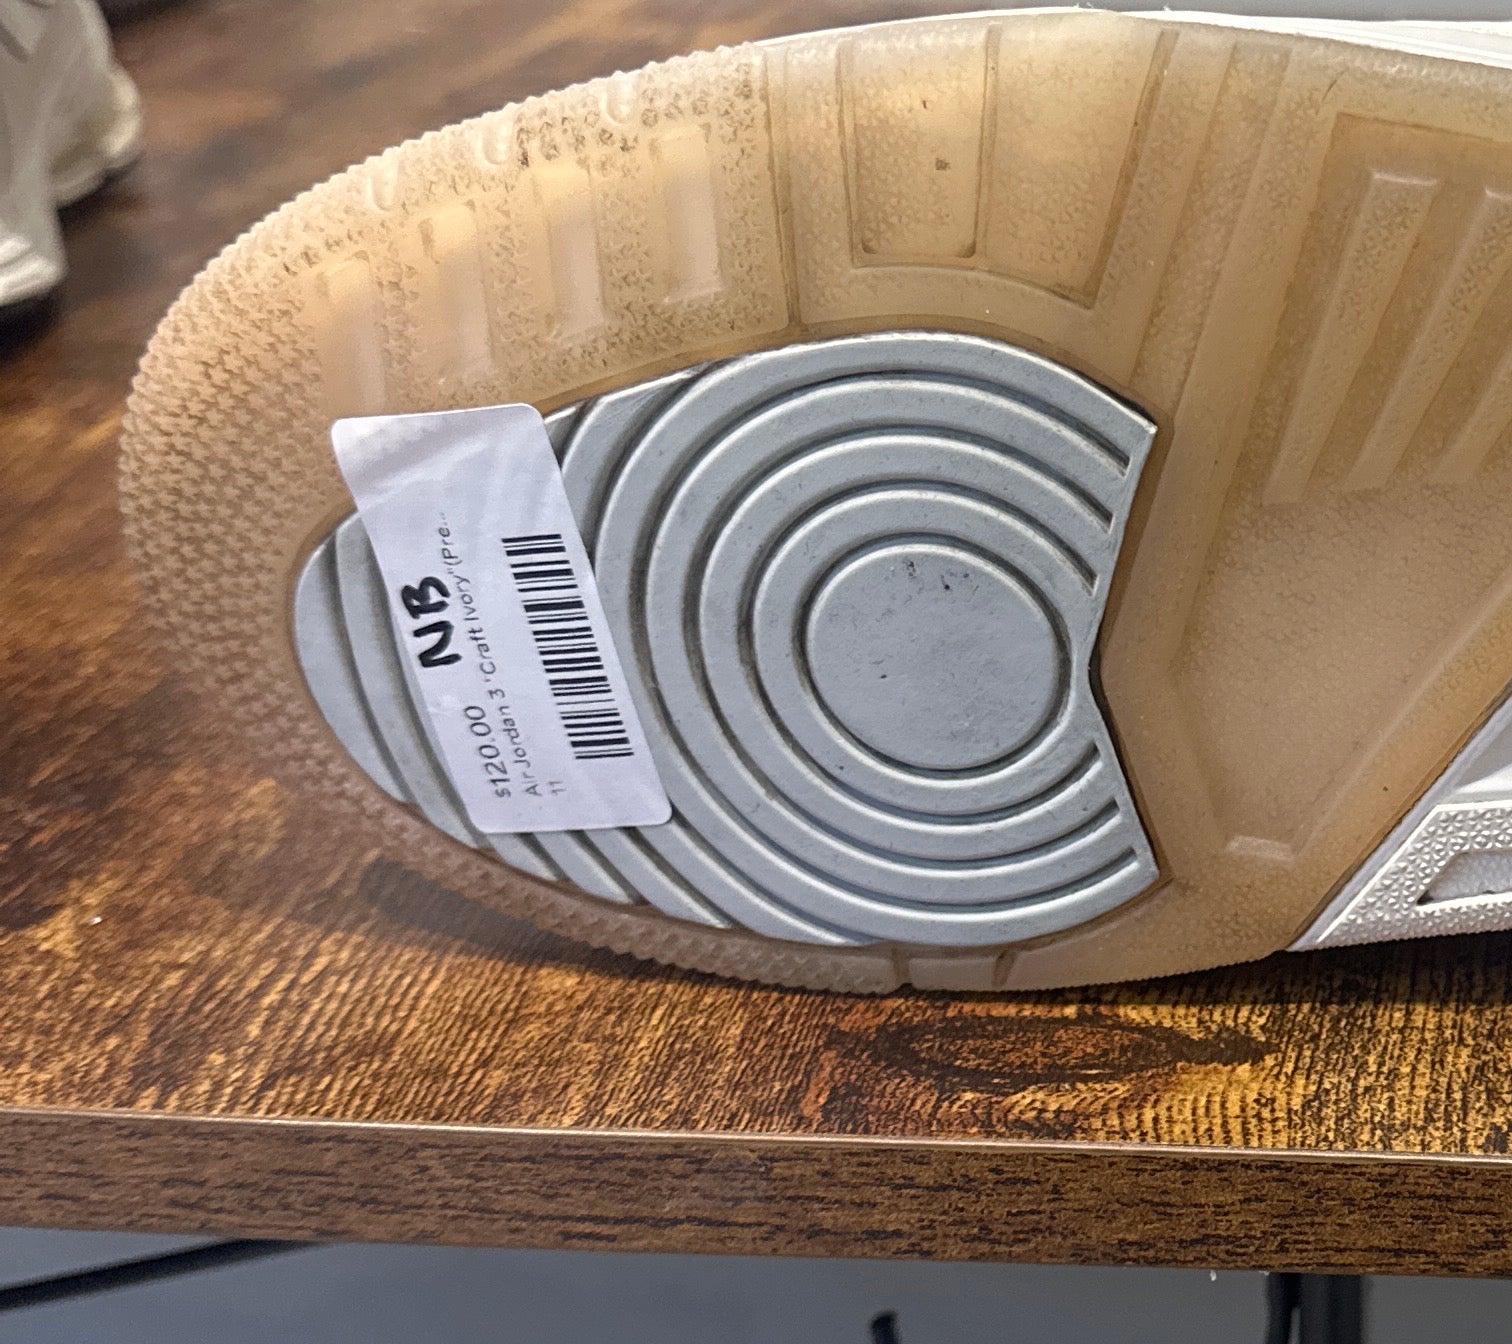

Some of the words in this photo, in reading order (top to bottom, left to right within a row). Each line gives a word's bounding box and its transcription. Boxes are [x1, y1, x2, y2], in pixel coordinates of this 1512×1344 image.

[402, 575, 462, 668] NB
[487, 688, 506, 700] 3
[464, 705, 511, 797] $120.00
[498, 705, 531, 768] Jordan
[522, 771, 543, 796] Air
